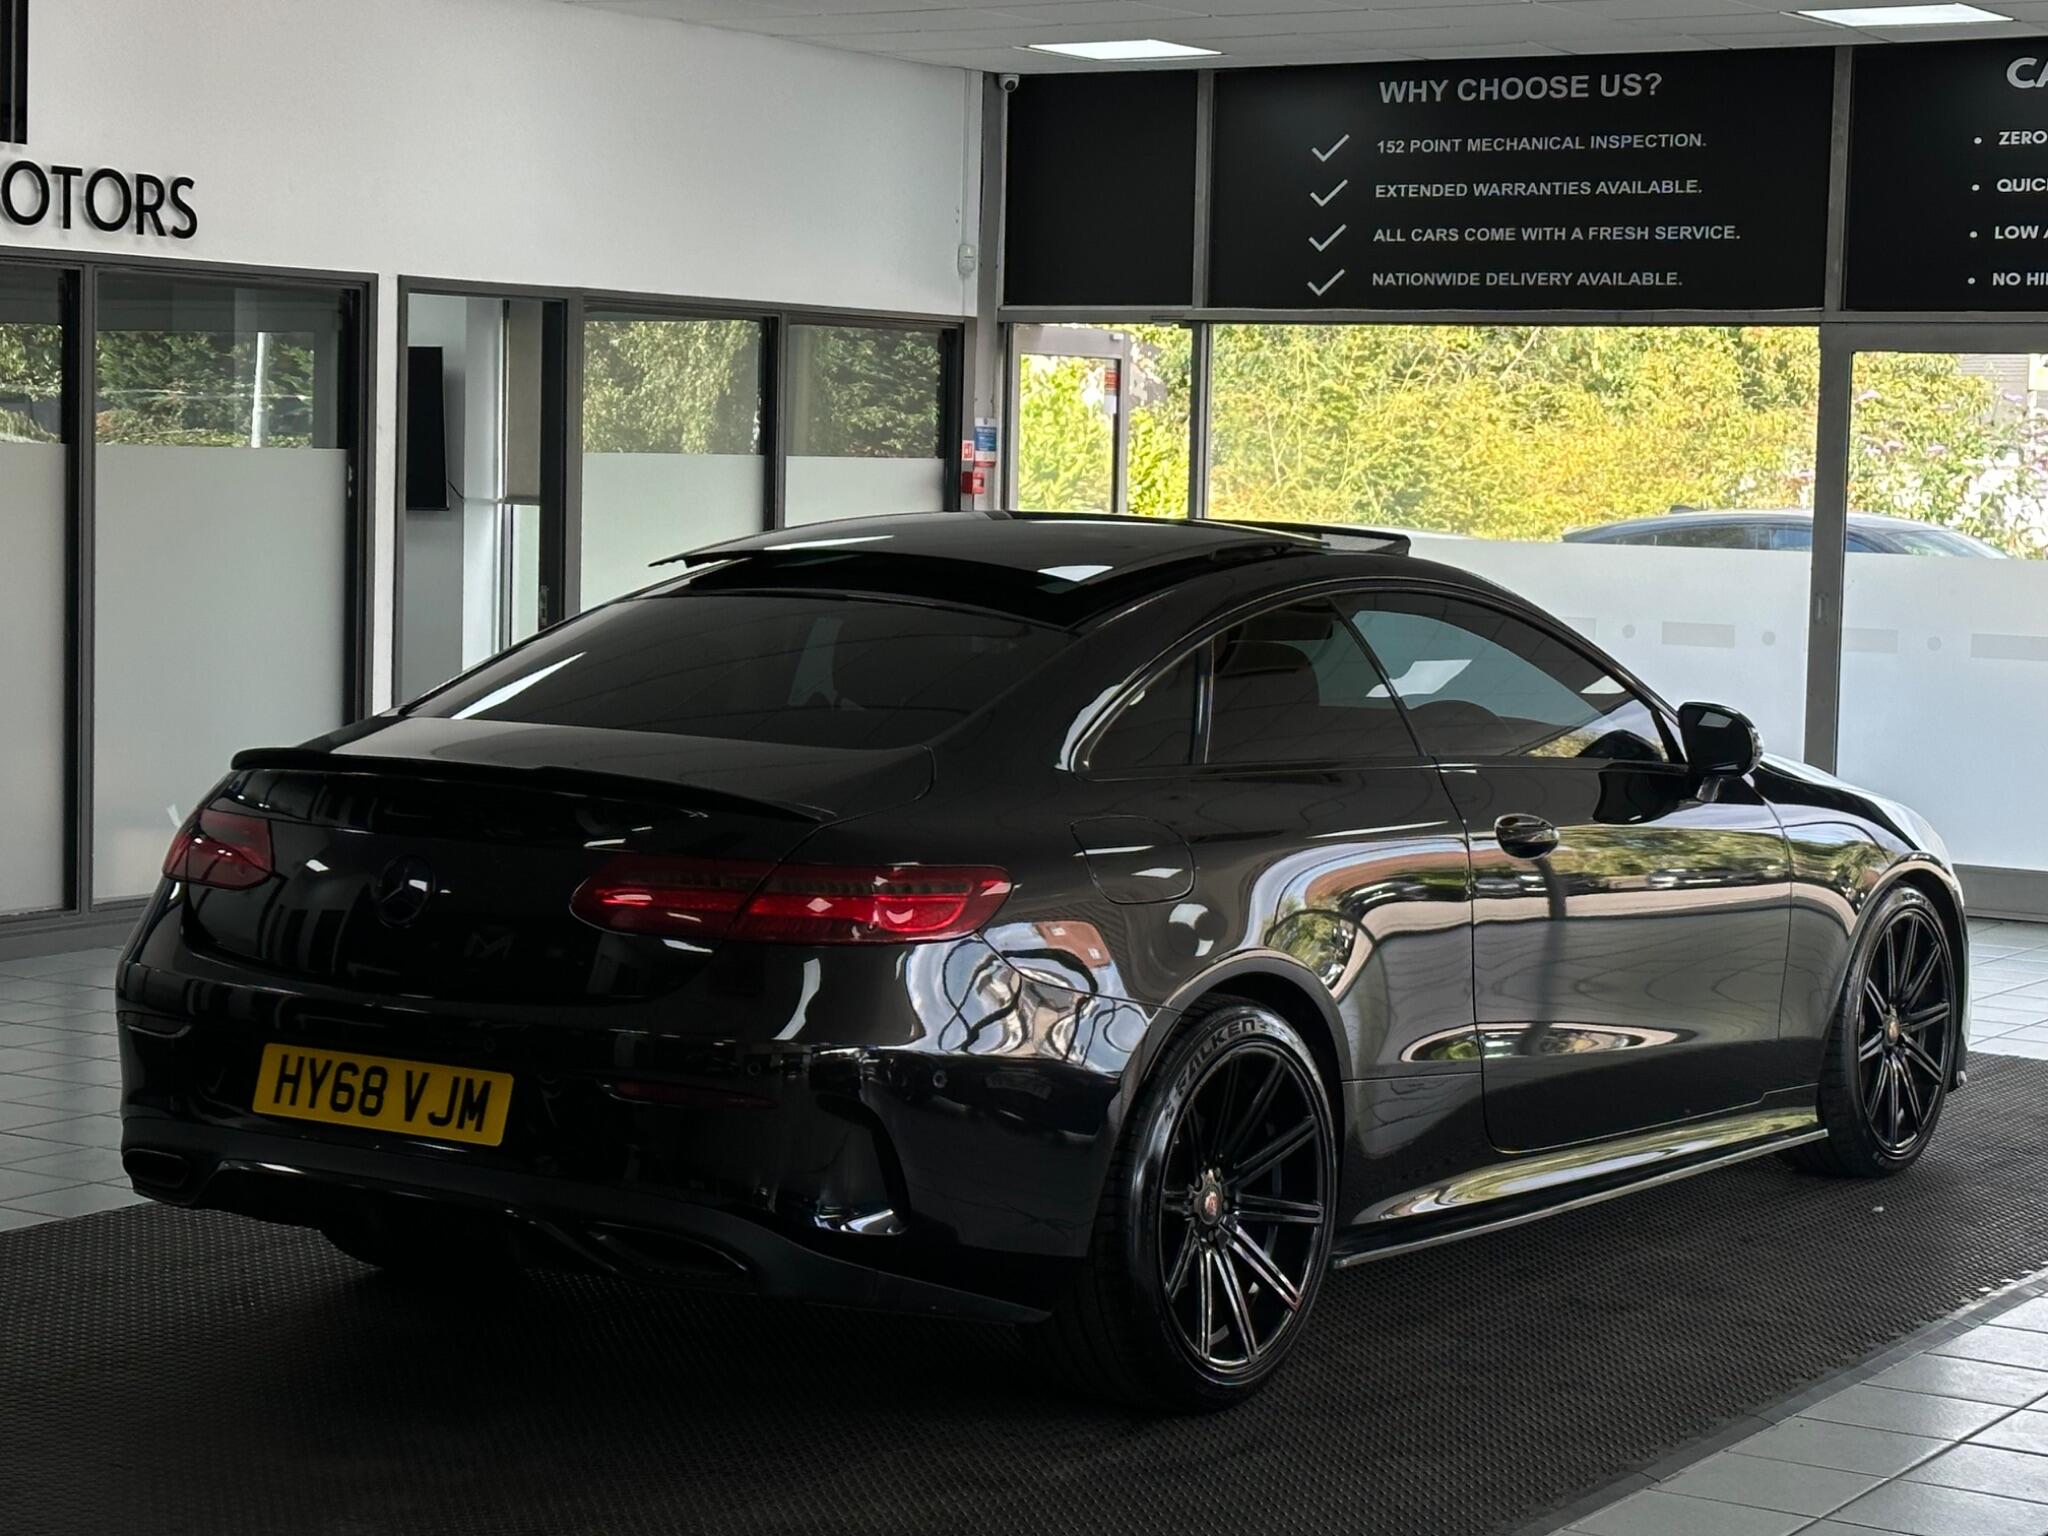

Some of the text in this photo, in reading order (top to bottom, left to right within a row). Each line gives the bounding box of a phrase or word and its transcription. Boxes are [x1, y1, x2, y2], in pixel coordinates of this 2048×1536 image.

[1379, 72, 1662, 104] WHY CHOOSE US?
[1377, 133, 1707, 154] 152 POINT MECHANICAL INSPECTION.
[1998, 130, 2048, 146] ZERO
[1375, 179, 1703, 198] EXTENDED WARRANTIES AVAILABLE.
[1996, 177, 2048, 193] QUIC
[1, 160, 198, 239] OTORS
[1372, 225, 1741, 243] ALL CARS COME WITH A FRESH SERVICE.
[1994, 225, 2039, 240] LOW
[1372, 271, 1683, 287] NATIONWIDE DELIVERY AVAILABLE.
[1992, 272, 2048, 287] NO HI
[1173, 1018, 1256, 1098] FALKEN
[272, 1054, 492, 1133] HY68 VJM
